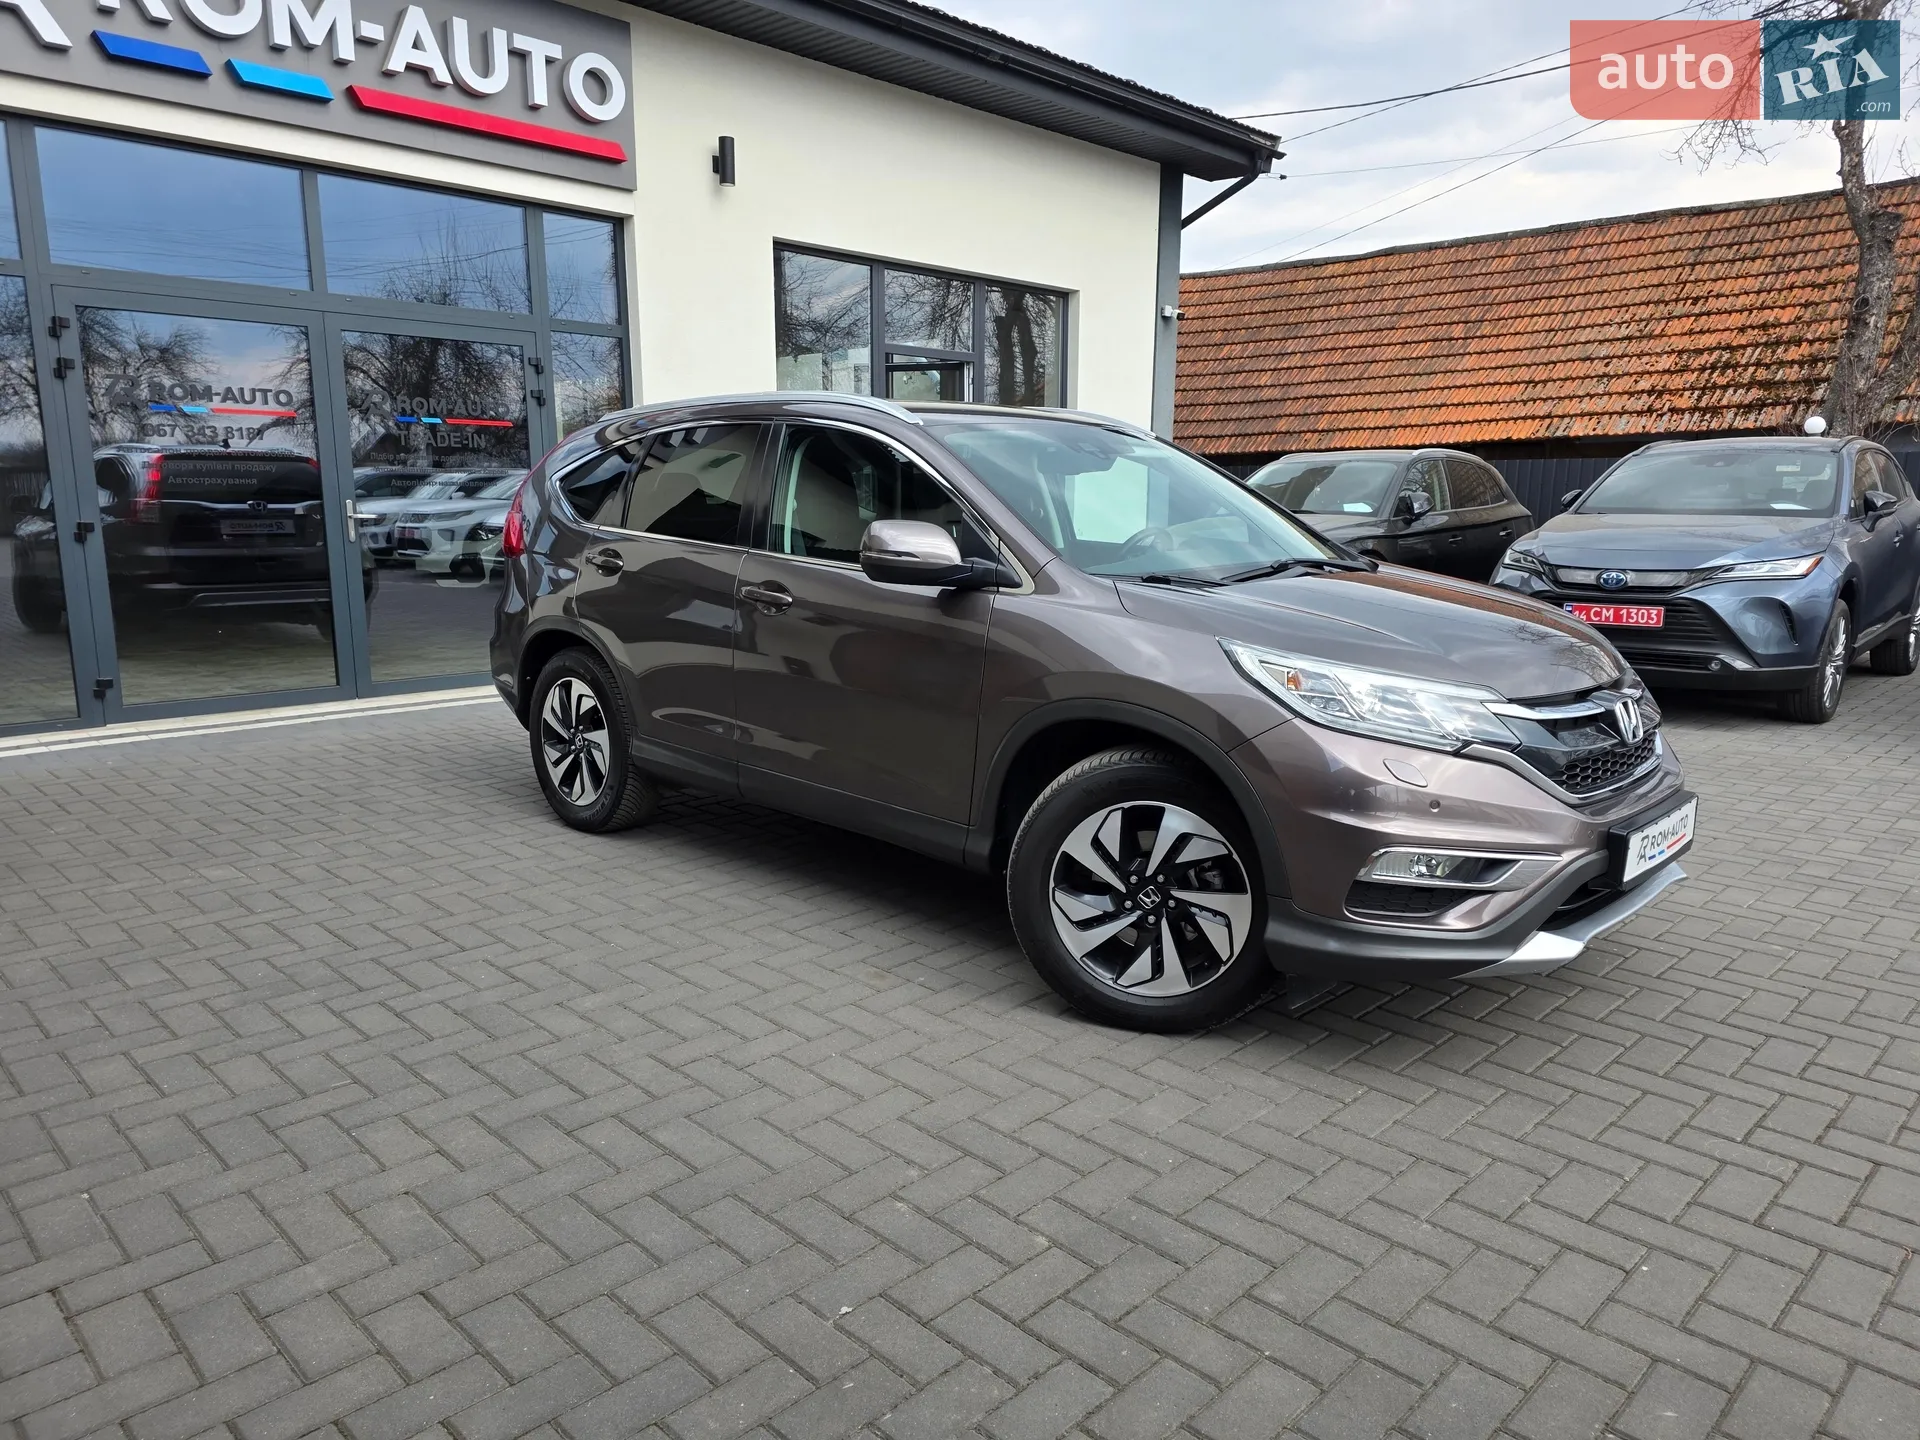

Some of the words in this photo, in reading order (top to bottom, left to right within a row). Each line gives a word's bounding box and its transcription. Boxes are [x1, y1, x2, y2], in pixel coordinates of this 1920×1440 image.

[95, 0, 627, 123] OM-AUTO
[148, 382, 294, 407] ROM-AUTO
[396, 395, 511, 418] ROM-AUTO
[400, 430, 487, 449] TRADE-IN
[184, 447, 229, 459] продаж
[234, 463, 277, 474] продажу
[167, 475, 258, 486] Автострахування
[1590, 607, 1614, 622] CM
[1619, 608, 1658, 624] 1303
[1649, 814, 1689, 851] ROM-AUTO
